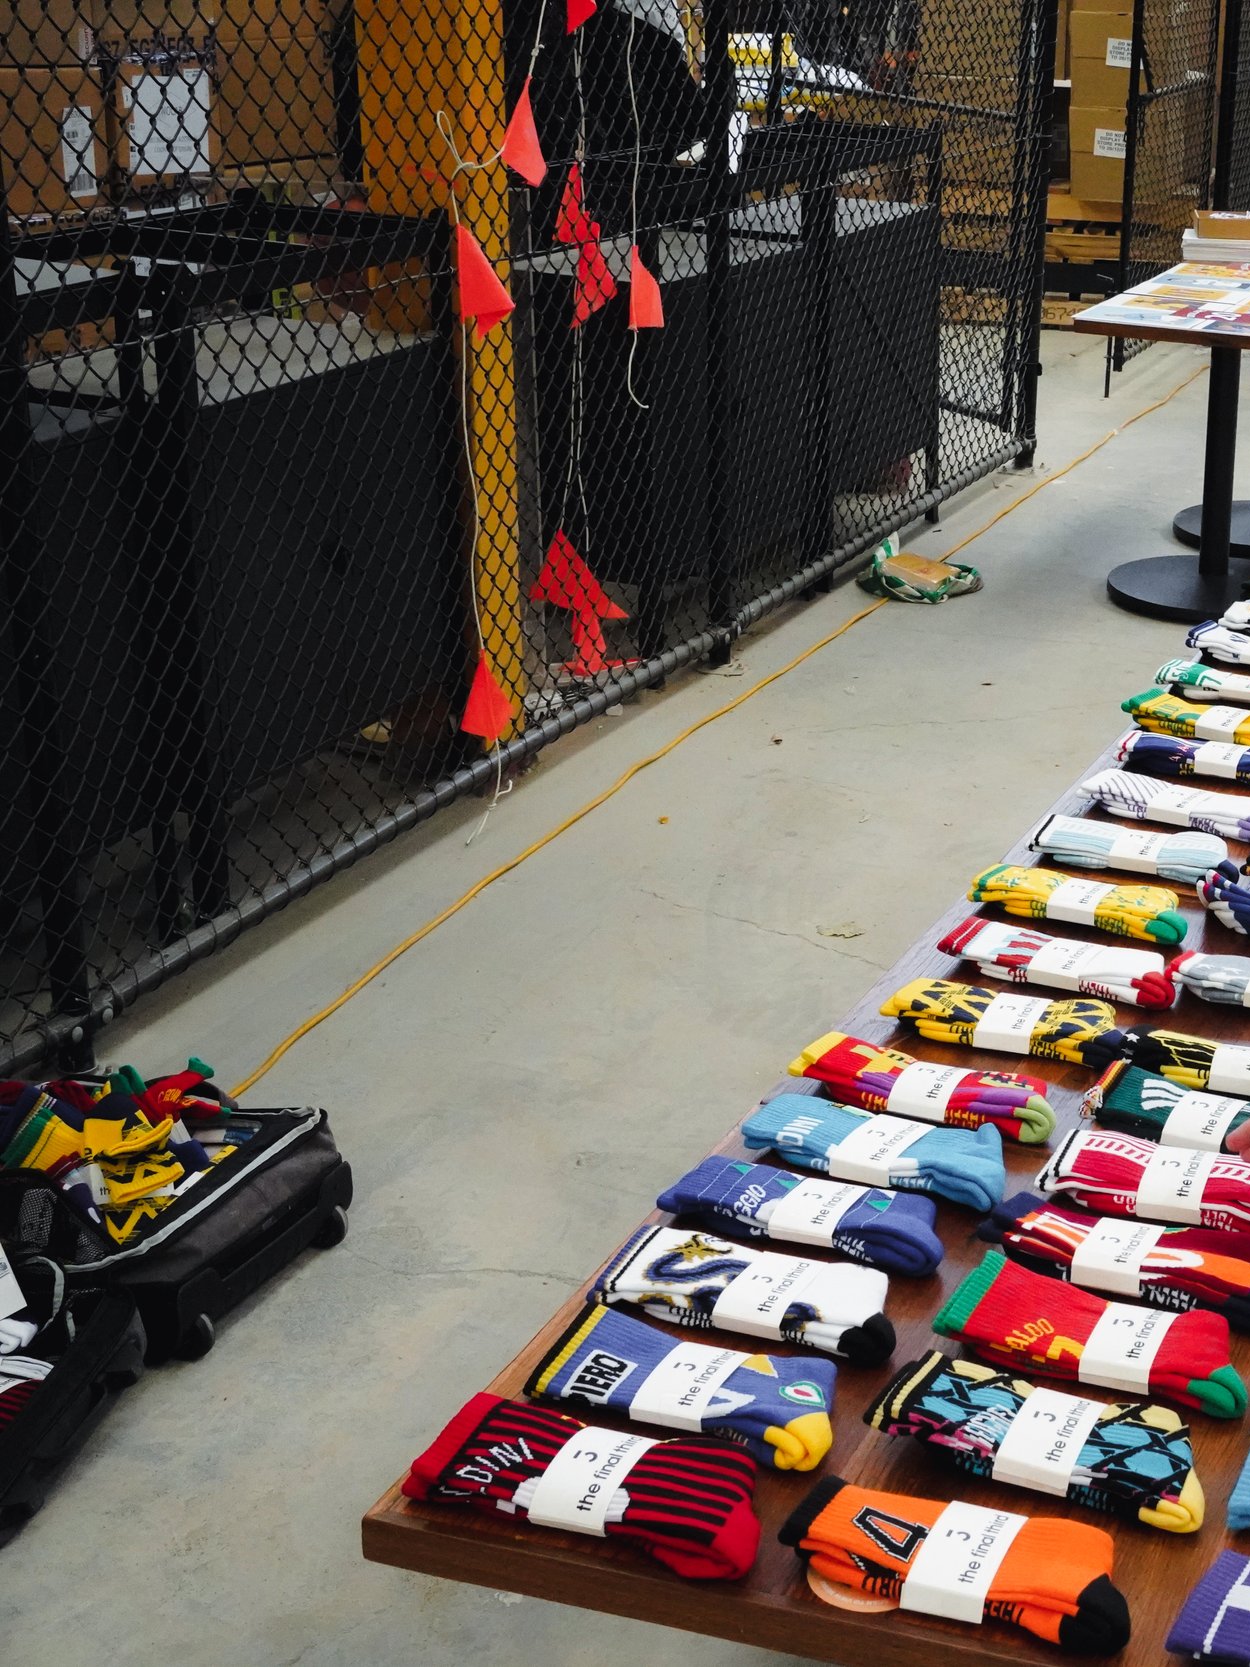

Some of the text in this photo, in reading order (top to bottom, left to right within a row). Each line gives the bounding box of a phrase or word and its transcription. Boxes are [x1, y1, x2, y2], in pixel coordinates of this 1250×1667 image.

[926, 1082, 942, 1098] the
[1201, 1119, 1217, 1135] the
[870, 1147, 888, 1161] the
[1177, 1179, 1192, 1197] the
[811, 1208, 830, 1225] the
[757, 1295, 778, 1312] the
[777, 1276, 794, 1295] final
[1126, 1341, 1144, 1358] the
[1139, 1320, 1155, 1339] final
[678, 1386, 695, 1407] the
[693, 1365, 717, 1385] final
[1045, 1441, 1066, 1462] the
[1058, 1417, 1079, 1439] final
[577, 1483, 600, 1512] the
[594, 1452, 621, 1481] final
[852, 1504, 932, 1563] 4
[958, 1515, 1008, 1583] the final third
